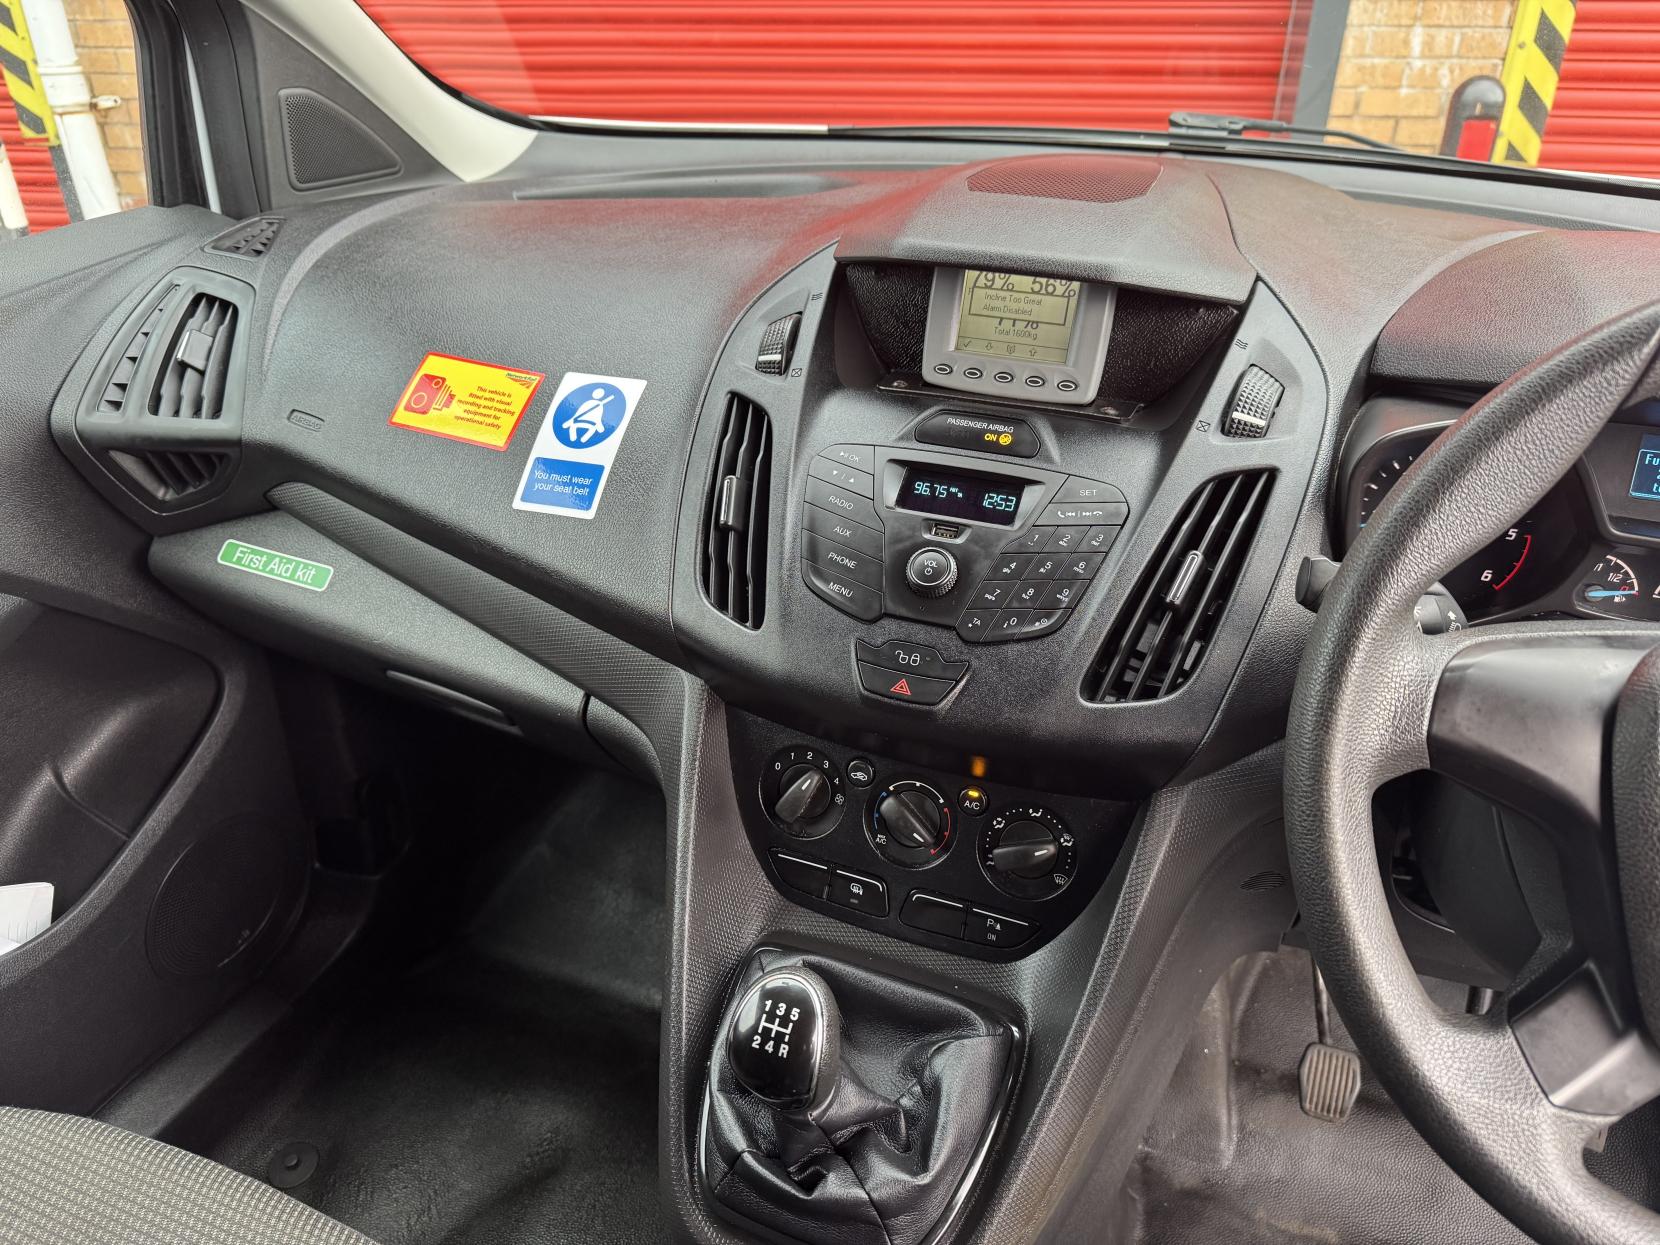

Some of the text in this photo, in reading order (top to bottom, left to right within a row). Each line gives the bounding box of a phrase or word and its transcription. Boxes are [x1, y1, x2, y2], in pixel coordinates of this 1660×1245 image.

[984, 292, 1042, 306] Incline Too Great
[983, 304, 1033, 316] Alarm Disabled
[994, 326, 1011, 336] Total
[468, 392, 483, 400] fitted
[488, 387, 507, 397] vehicle
[457, 399, 482, 409] recording
[494, 406, 516, 416] tracking
[464, 408, 492, 419] equipment
[454, 415, 502, 430] operational safety
[946, 418, 1014, 433] PASSENGER AIRBAG
[984, 432, 998, 442] ON
[534, 470, 593, 486] You must wear
[534, 482, 590, 496] your seat belt
[828, 495, 854, 510] RADIO
[914, 482, 1016, 511] 96.75 12:53
[832, 525, 852, 538] AUX
[1504, 528, 1518, 540] 5
[232, 547, 316, 584] First Aid kit
[828, 552, 858, 570] PHONE
[924, 560, 938, 568] VOL
[1010, 562, 1017, 570] 4
[1045, 562, 1053, 570] 5
[1078, 562, 1086, 570] 6
[1480, 570, 1493, 582] 6
[1608, 572, 1623, 582] 1/2
[828, 582, 854, 599] MENU
[994, 588, 1001, 596] 7
[1062, 588, 1070, 596] 9
[972, 618, 981, 626] TA
[1010, 618, 1018, 626] 0
[774, 762, 781, 770] 0
[790, 752, 794, 760] 1
[806, 752, 813, 760] 2
[823, 760, 829, 768] 3
[964, 800, 980, 810] A/C
[987, 932, 996, 942] ON
[765, 1000, 800, 1020] 1 3 5
[752, 1035, 789, 1058] 2 4 R
